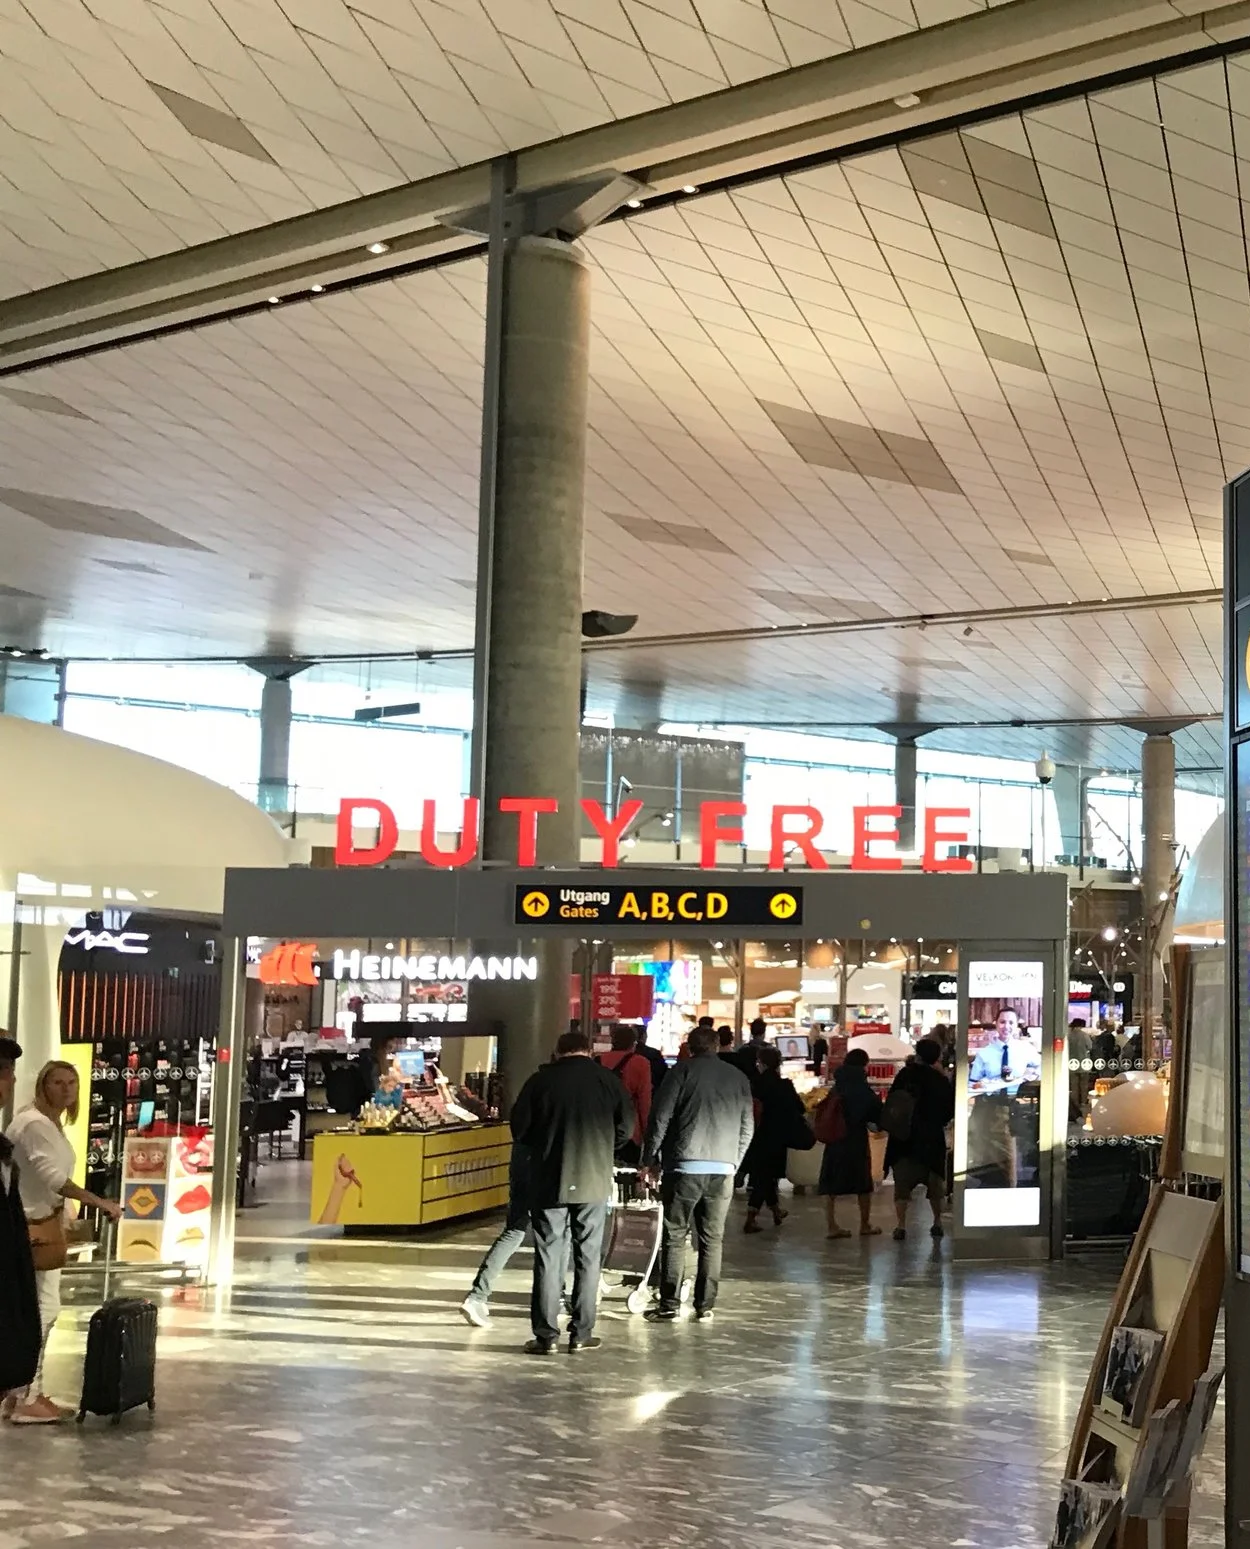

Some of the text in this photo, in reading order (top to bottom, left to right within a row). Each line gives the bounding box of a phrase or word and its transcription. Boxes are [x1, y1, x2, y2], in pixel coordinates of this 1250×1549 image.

[335, 797, 973, 871] DUTY FREE
[560, 889, 728, 921] Utgang A,B,C,D
[560, 905, 599, 918] Gates
[333, 949, 538, 980] HEINEMANN
